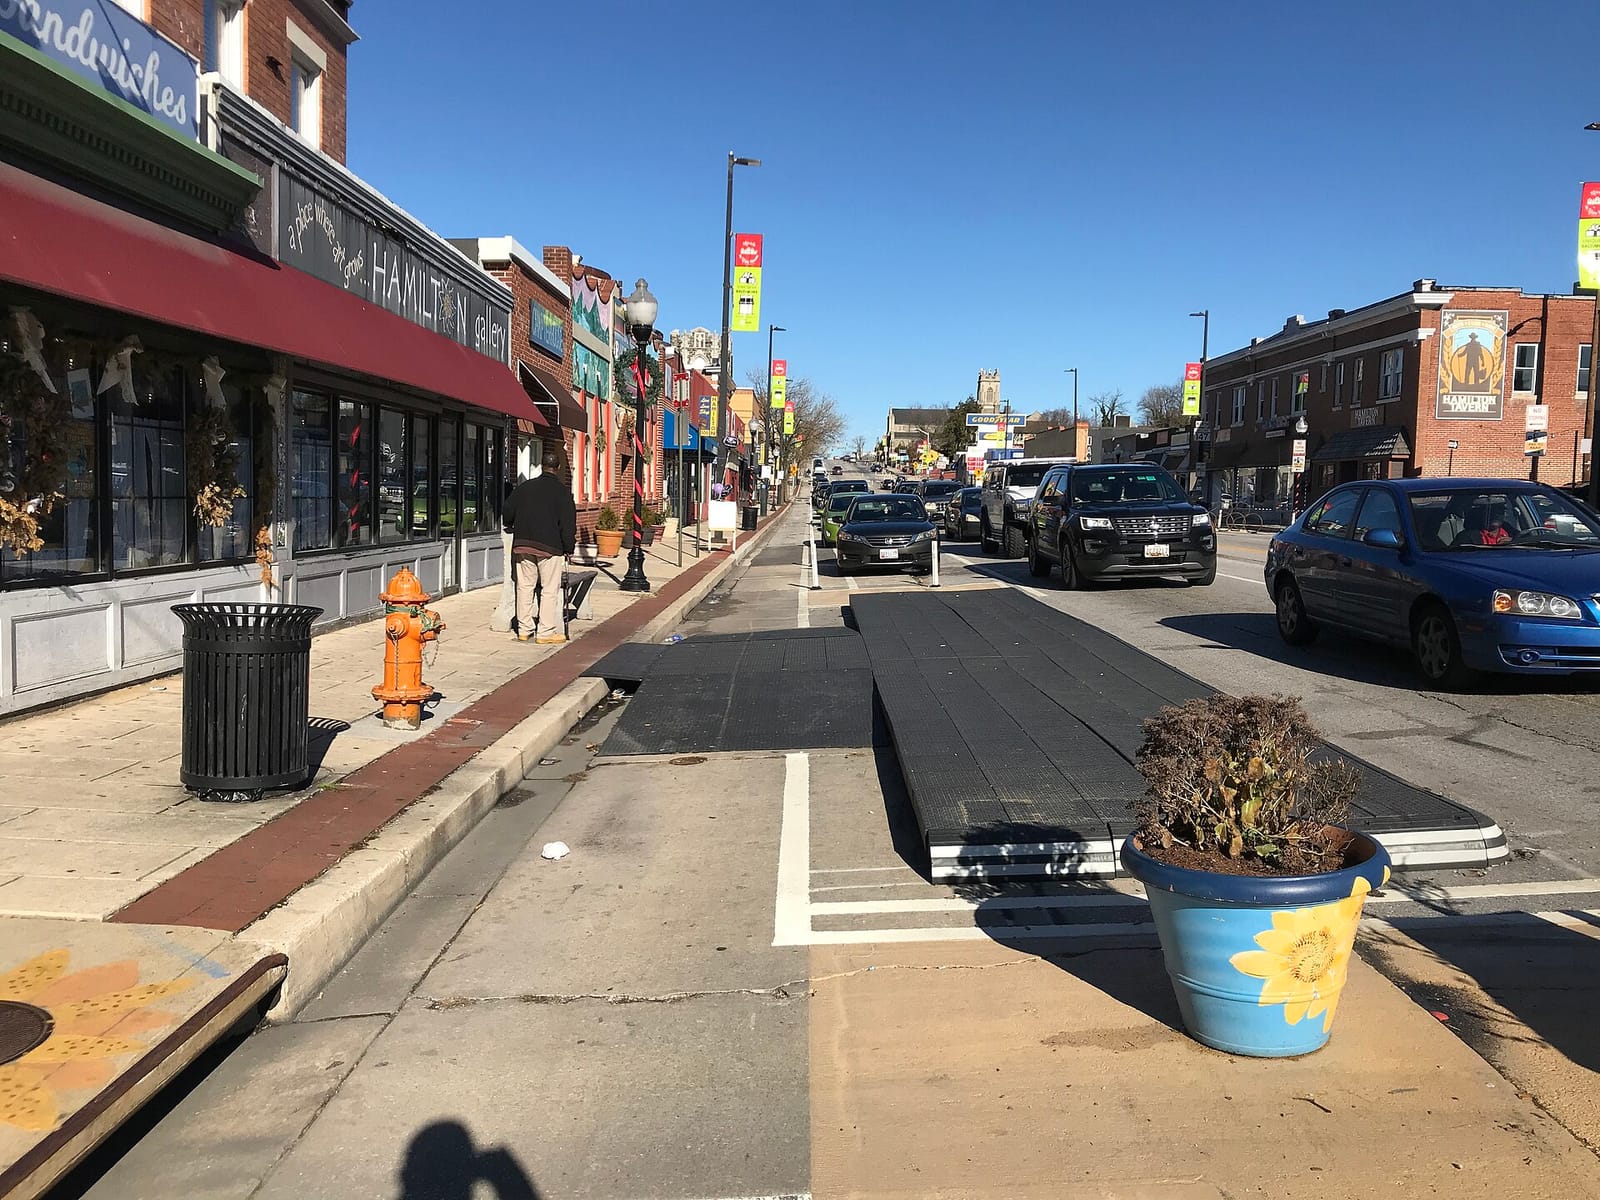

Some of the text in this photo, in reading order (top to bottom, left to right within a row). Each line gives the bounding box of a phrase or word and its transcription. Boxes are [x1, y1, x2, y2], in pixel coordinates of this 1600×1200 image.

[0, 0, 187, 125] andwiches
[288, 224, 297, 250] a
[295, 202, 314, 254] place
[314, 199, 336, 245] where
[475, 304, 506, 362] gallery
[1442, 395, 1497, 405] HAMILTON
[1451, 403, 1489, 412] TAVERN
